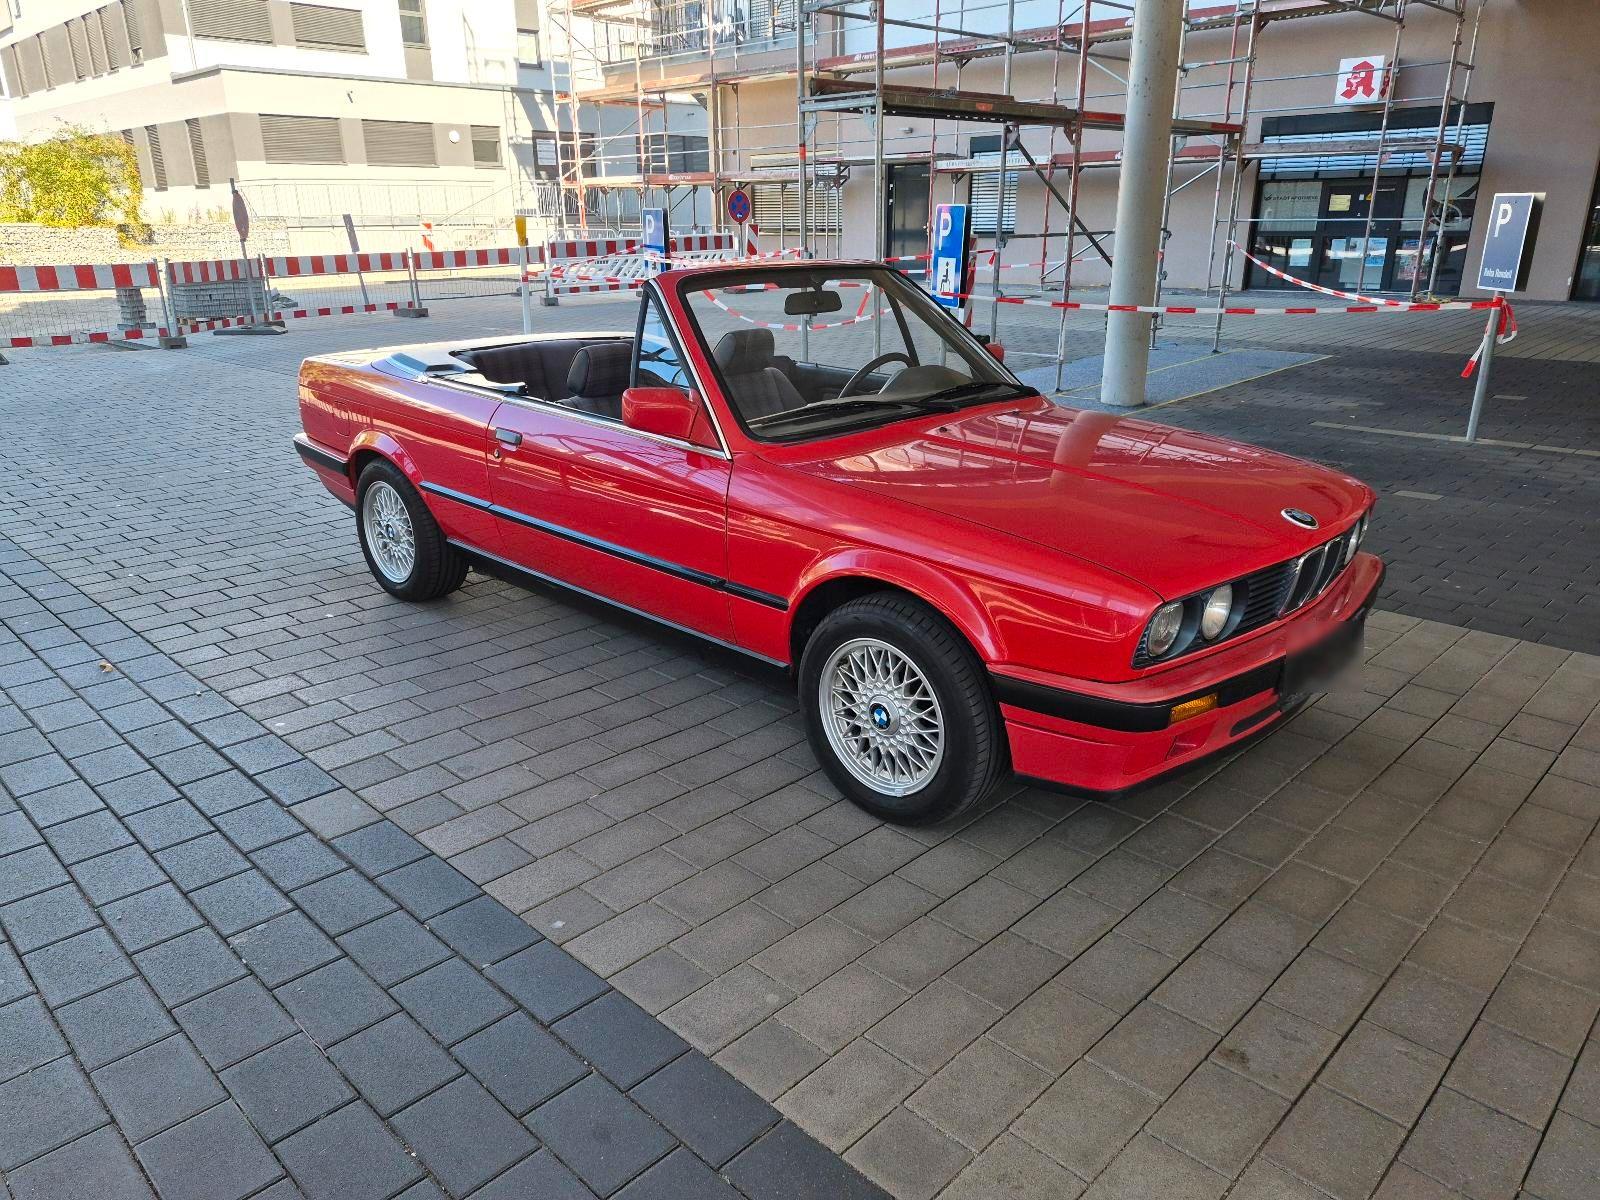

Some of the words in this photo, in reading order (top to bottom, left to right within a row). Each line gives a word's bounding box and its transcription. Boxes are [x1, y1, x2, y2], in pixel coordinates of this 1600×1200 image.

[645, 214, 655, 243] P
[938, 212, 952, 251] P
[1494, 203, 1512, 237] P
